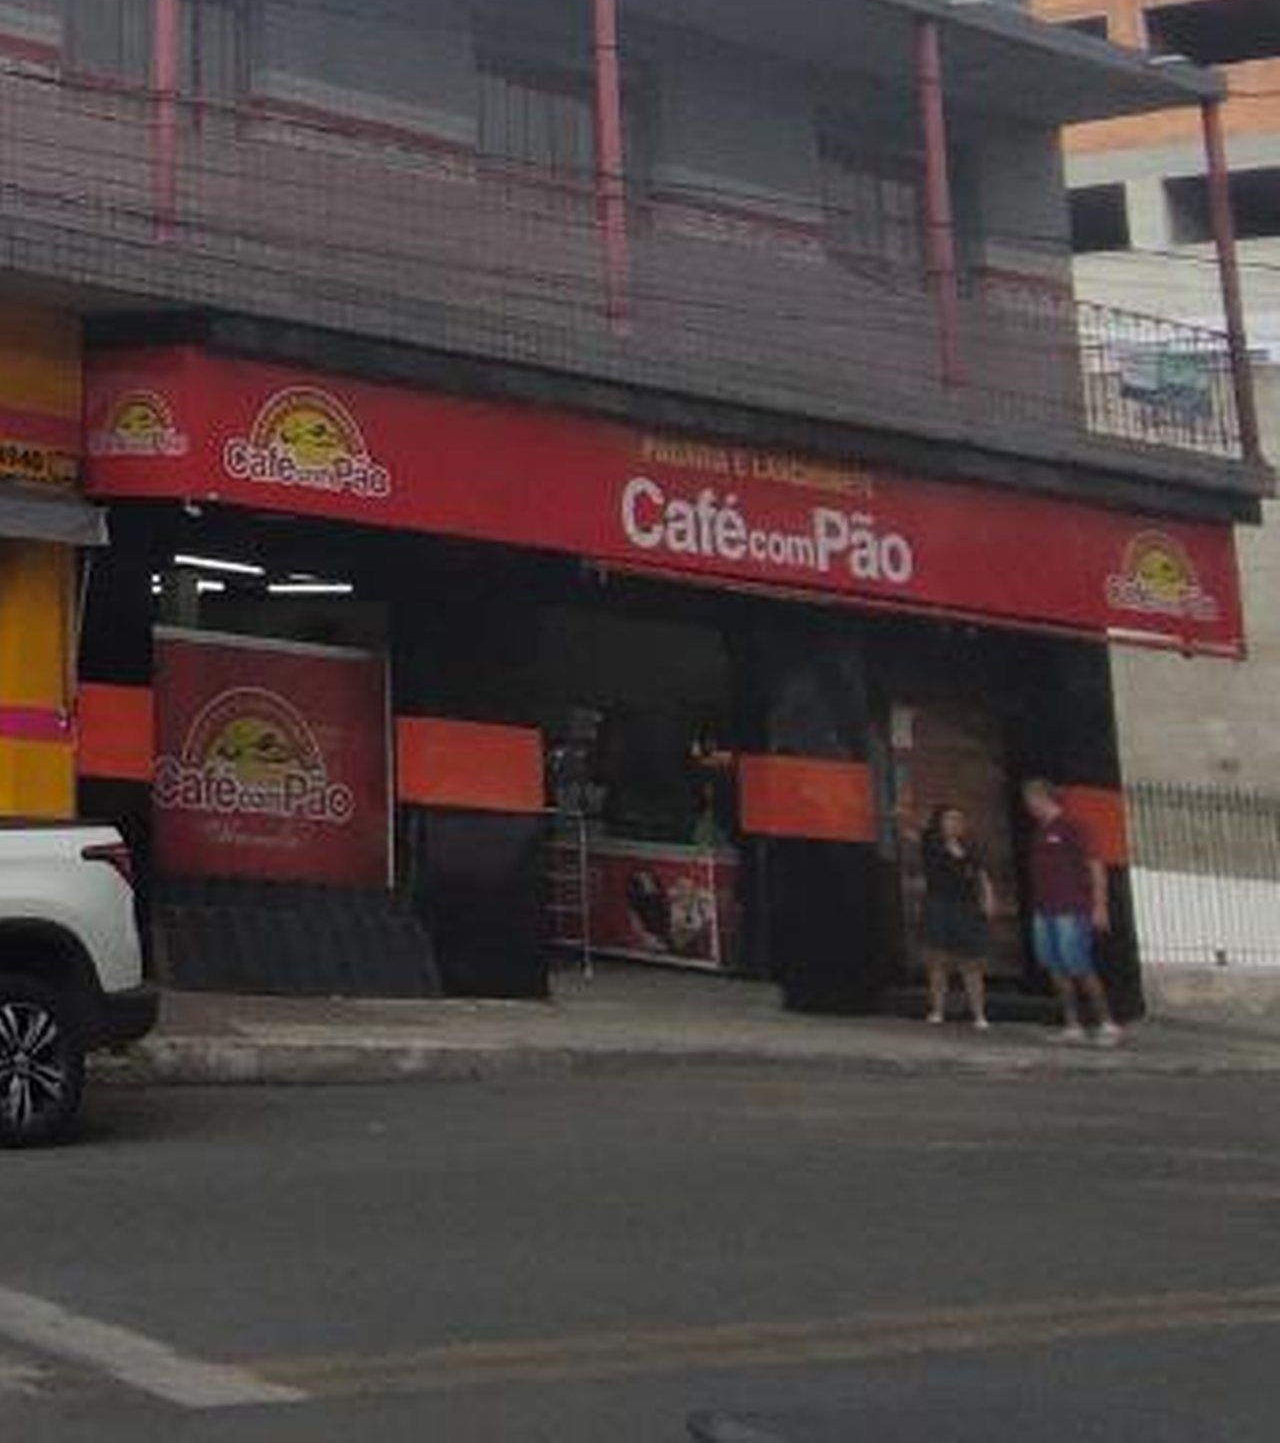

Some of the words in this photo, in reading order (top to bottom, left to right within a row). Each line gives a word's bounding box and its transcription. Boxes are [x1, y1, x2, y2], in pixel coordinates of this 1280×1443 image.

[622, 476, 748, 564] Café
[748, 531, 816, 567] com
[813, 507, 913, 584] Pão
